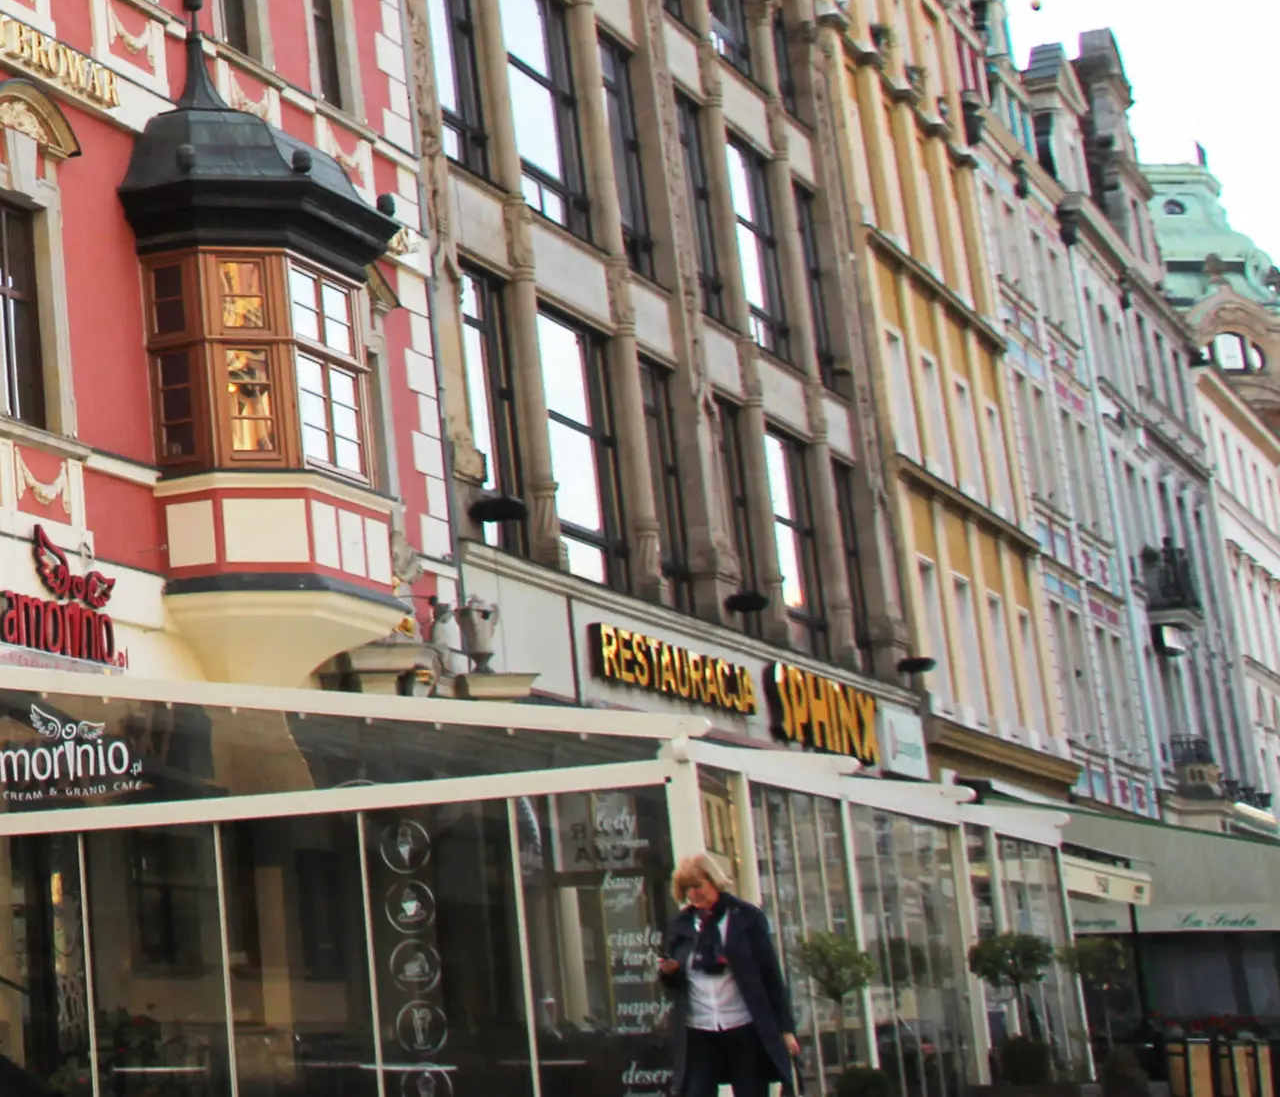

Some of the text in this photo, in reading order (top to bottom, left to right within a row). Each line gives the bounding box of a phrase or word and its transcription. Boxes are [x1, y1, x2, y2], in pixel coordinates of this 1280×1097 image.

[5, 19, 122, 108] BROWAR
[593, 622, 881, 765] RESTAURACJA SPHINX
[3, 789, 43, 802] CREAM
[49, 787, 58, 797] &
[65, 783, 107, 798] GRAND
